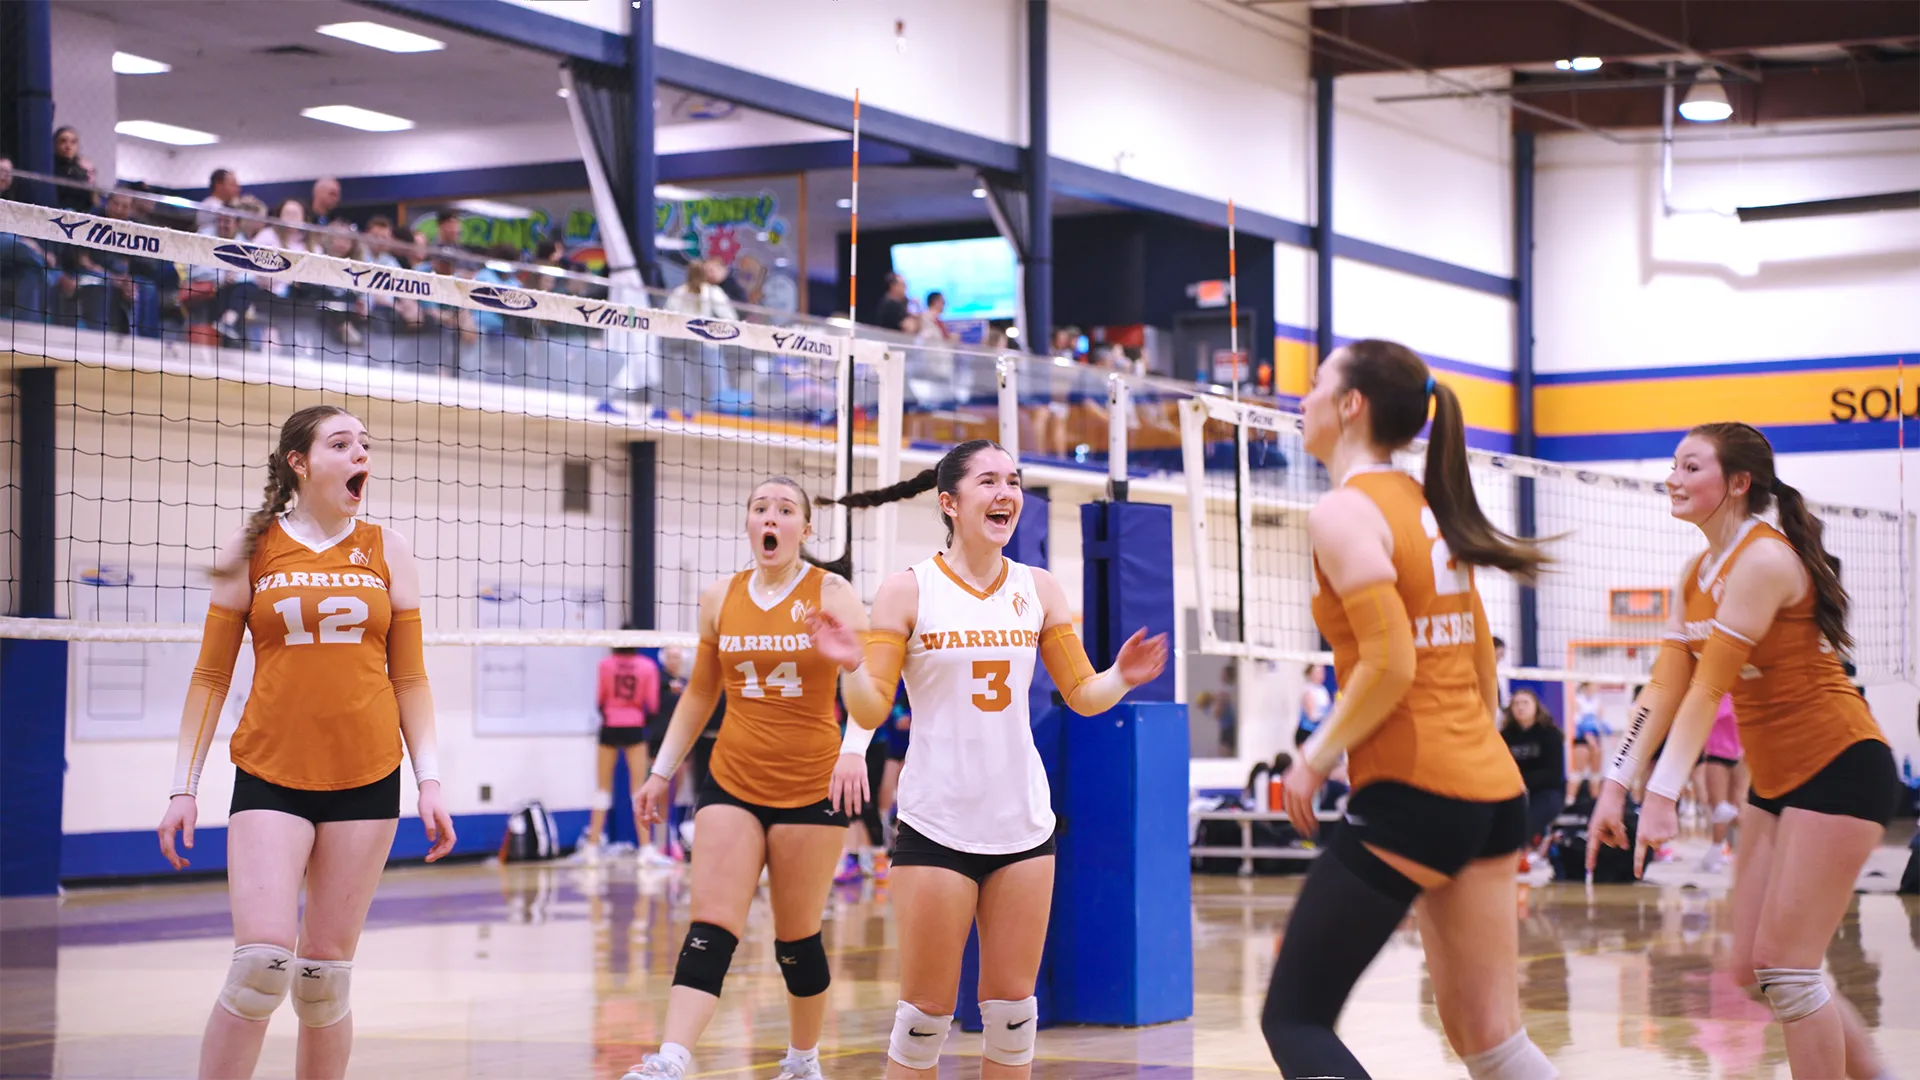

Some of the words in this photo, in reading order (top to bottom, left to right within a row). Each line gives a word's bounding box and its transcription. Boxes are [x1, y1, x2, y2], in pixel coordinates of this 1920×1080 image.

[272, 596, 369, 646] 12
[718, 633, 812, 653] WARRIOR
[613, 674, 638, 702] 19
[734, 660, 803, 698] 14
[971, 660, 1012, 712] 3
